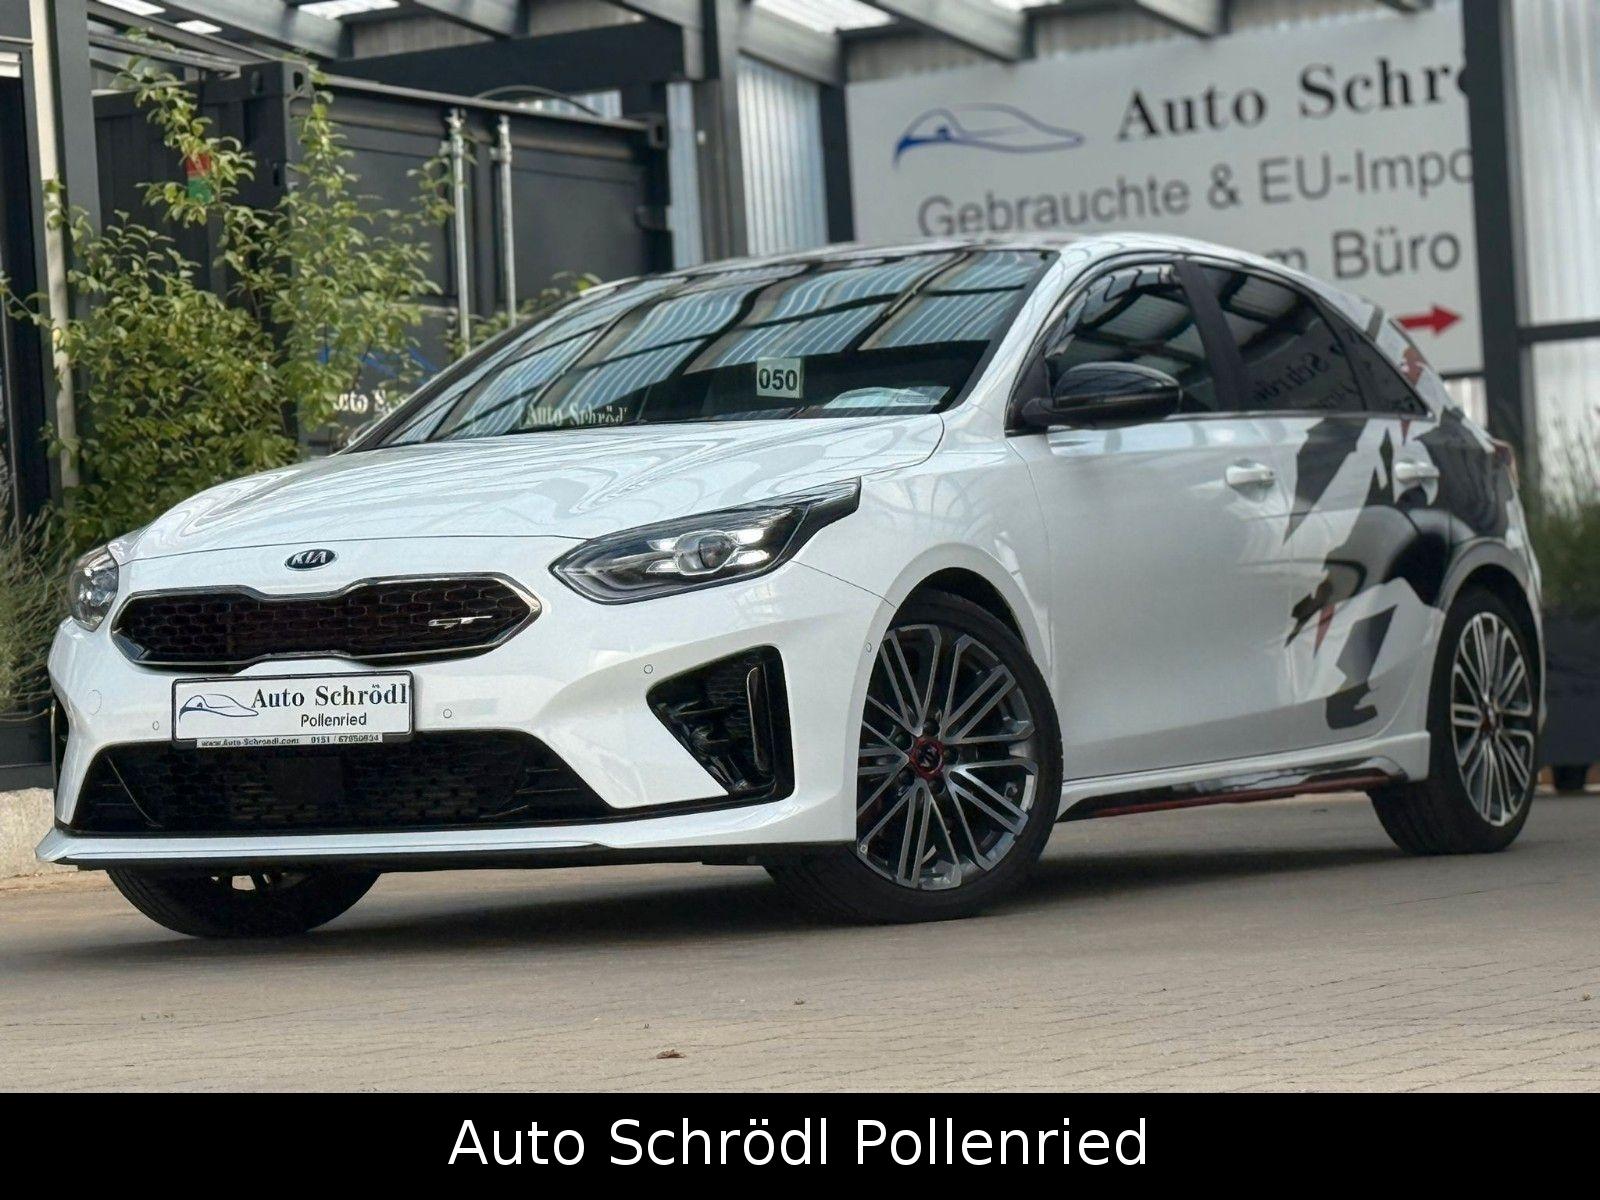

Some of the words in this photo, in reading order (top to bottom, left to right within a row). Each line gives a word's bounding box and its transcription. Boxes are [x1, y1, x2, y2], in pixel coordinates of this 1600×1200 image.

[1115, 86, 1267, 142] Auto
[917, 175, 1192, 237] Gebrauchte
[1207, 163, 1242, 209] &
[1332, 226, 1461, 280] Büro
[758, 367, 798, 392] 050
[332, 390, 369, 414] uto
[291, 550, 327, 565] KIA
[251, 687, 305, 709] Auto
[315, 682, 408, 708] Schrödl
[300, 712, 367, 728] Pollenried
